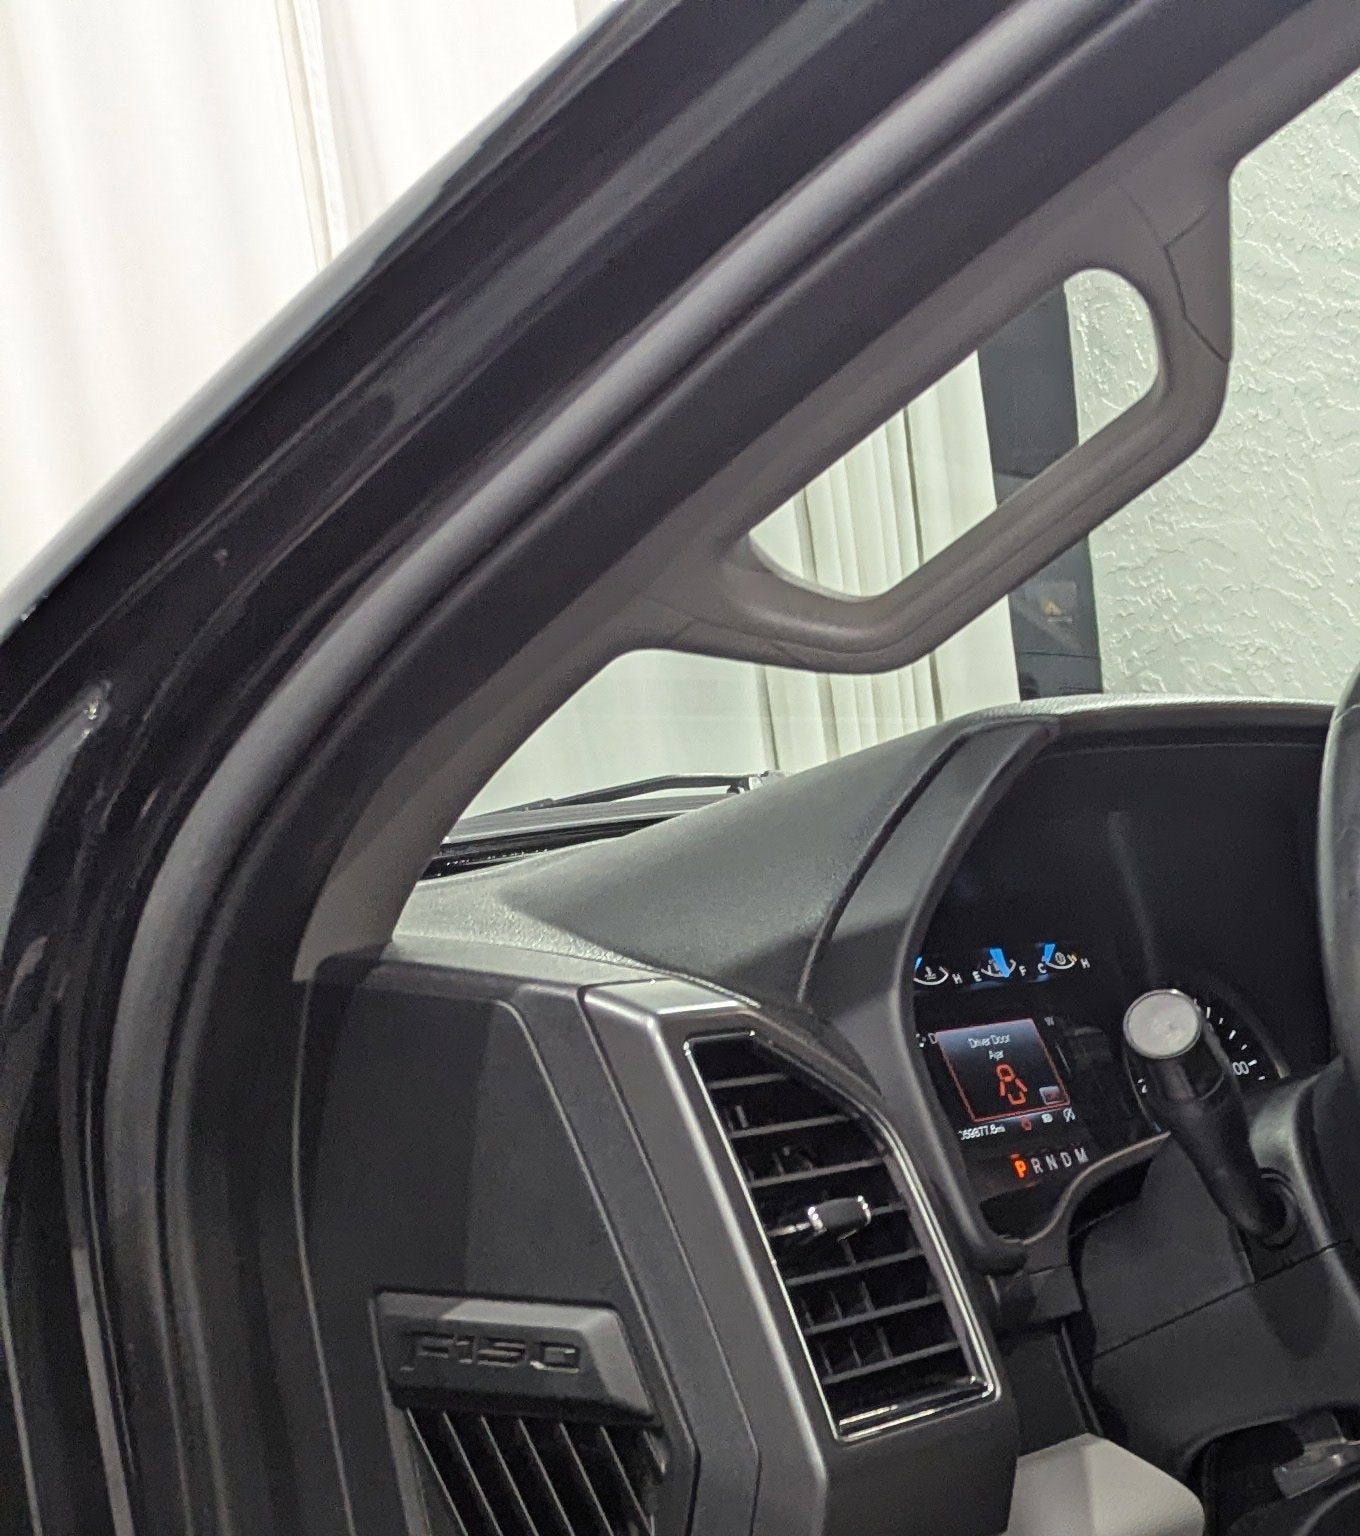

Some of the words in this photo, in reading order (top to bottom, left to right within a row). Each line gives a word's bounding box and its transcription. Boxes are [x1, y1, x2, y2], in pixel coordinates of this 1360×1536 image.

[973, 971, 982, 982] E
[1019, 965, 1027, 976] F
[1037, 962, 1047, 974] C
[952, 973, 963, 985] H
[1014, 1159, 1027, 1178] P
[1030, 1158, 1044, 1175] R
[1045, 1154, 1059, 1171] N
[1060, 1151, 1073, 1168] D
